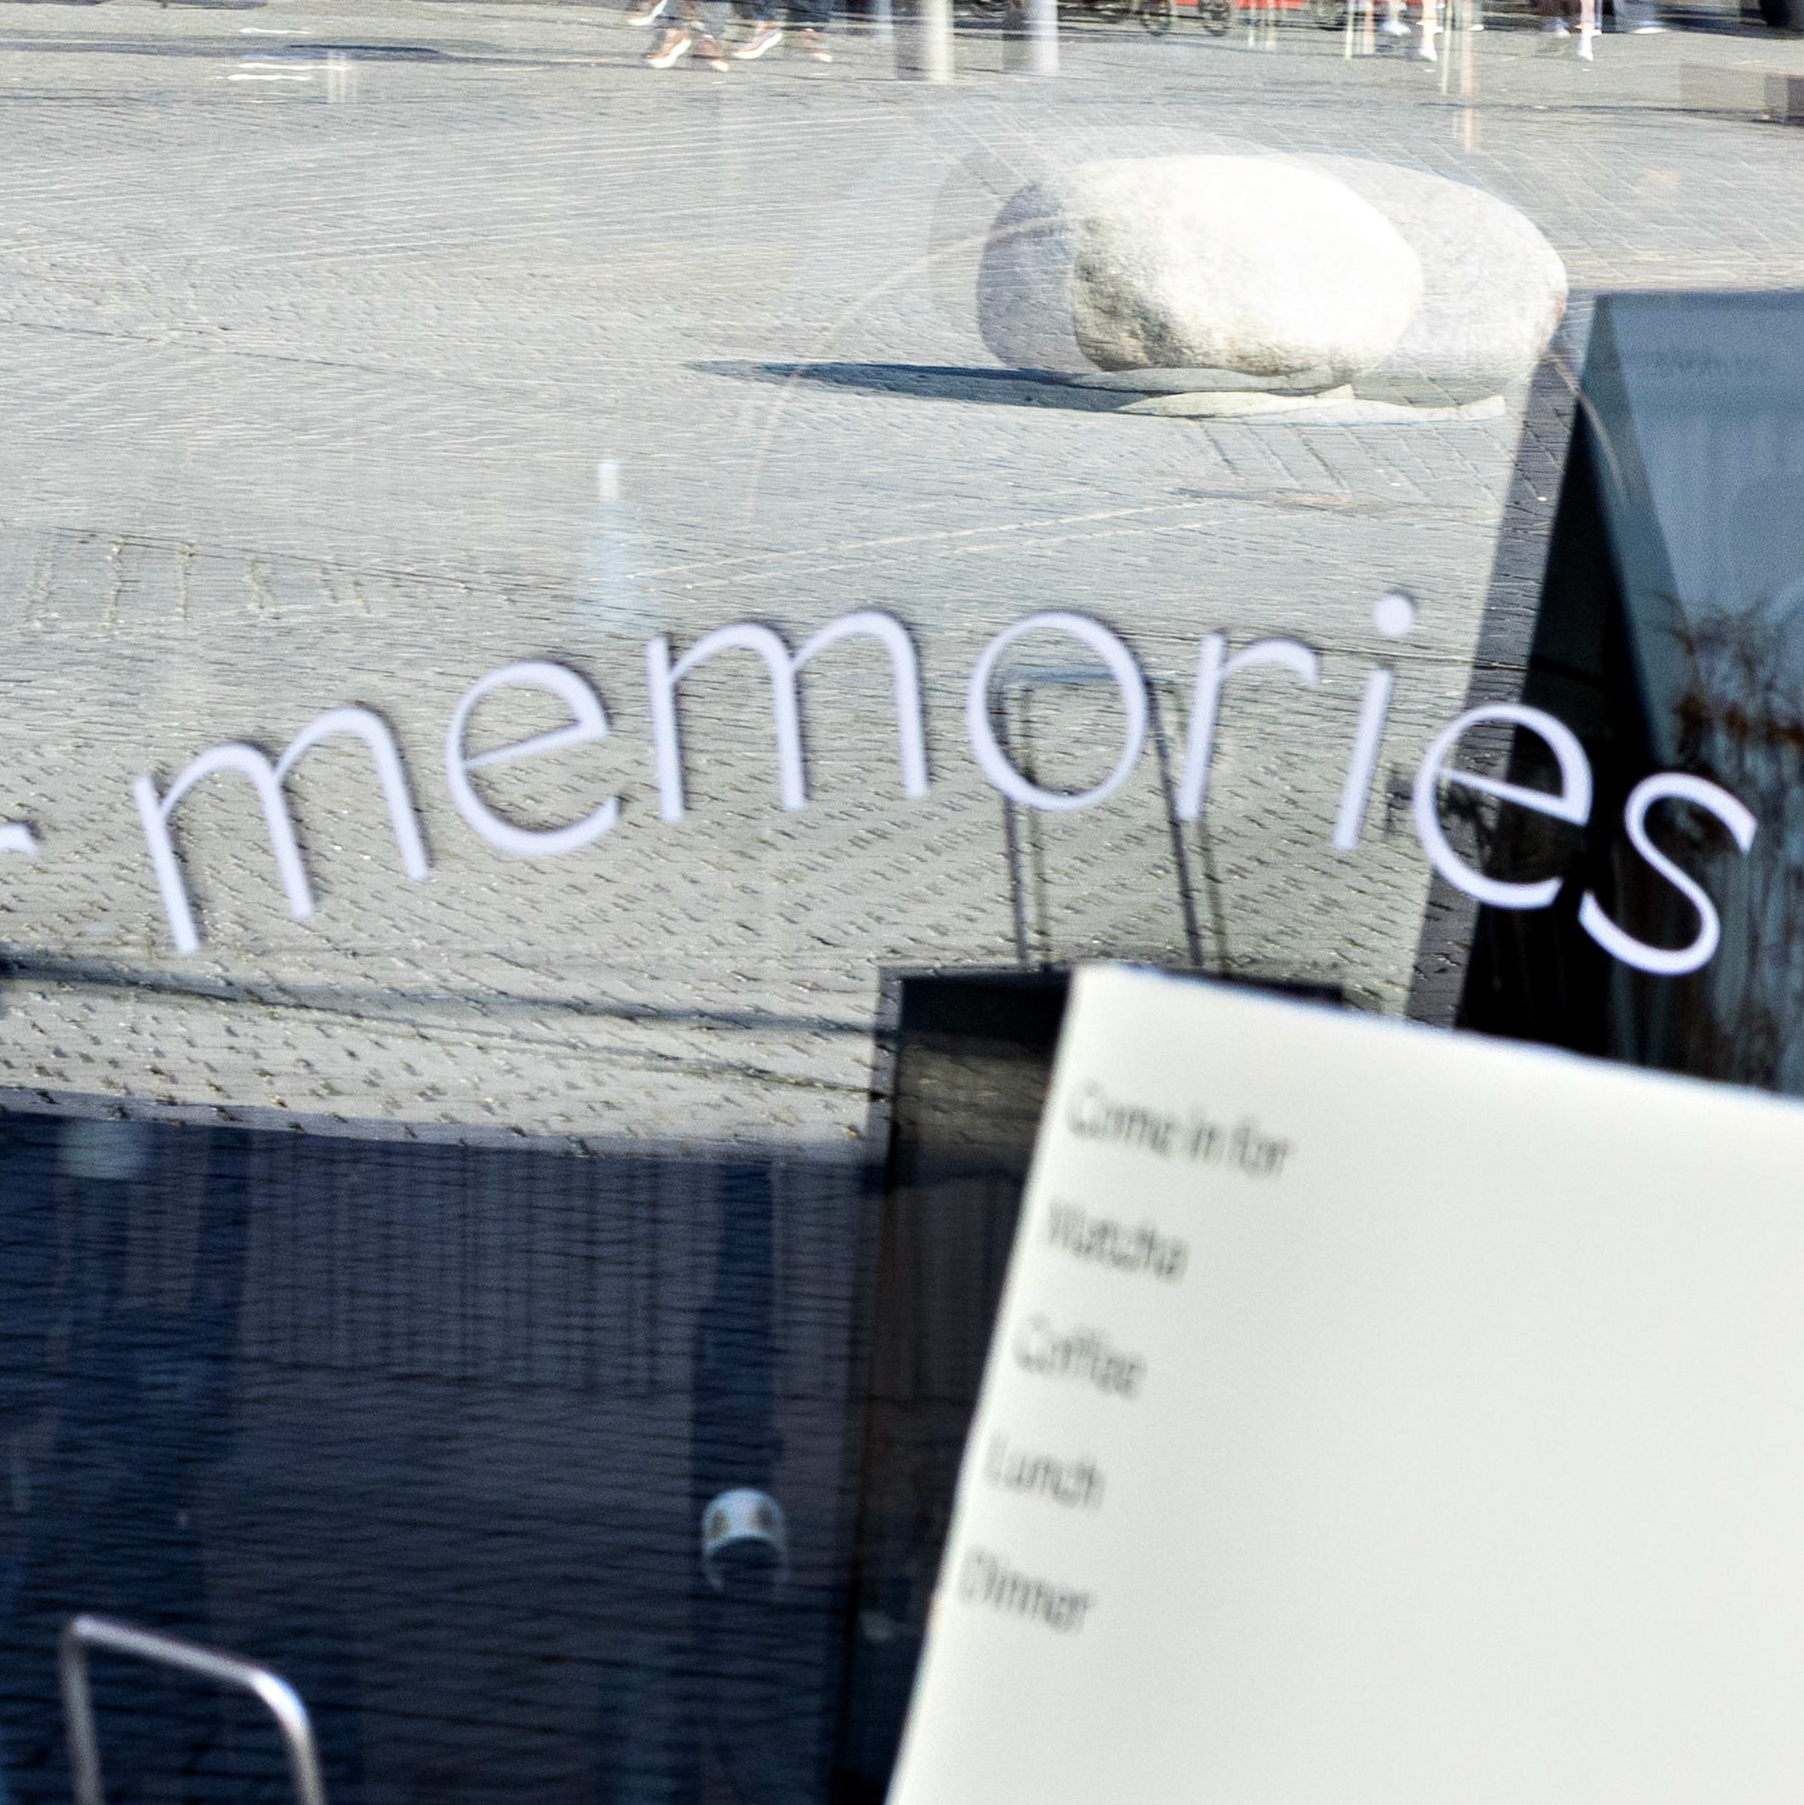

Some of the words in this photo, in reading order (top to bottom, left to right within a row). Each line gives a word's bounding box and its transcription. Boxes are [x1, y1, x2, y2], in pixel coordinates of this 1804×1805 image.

[134, 592, 1758, 976] memories
[1066, 1083, 1175, 1161] Come
[1184, 1104, 1226, 1166] in
[1228, 1113, 1297, 1180] for
[1044, 1198, 1190, 1284] Matcha
[1012, 1313, 1148, 1401] Coffee
[981, 1428, 1107, 1512] Lunch
[955, 1542, 1097, 1636] Dinner
